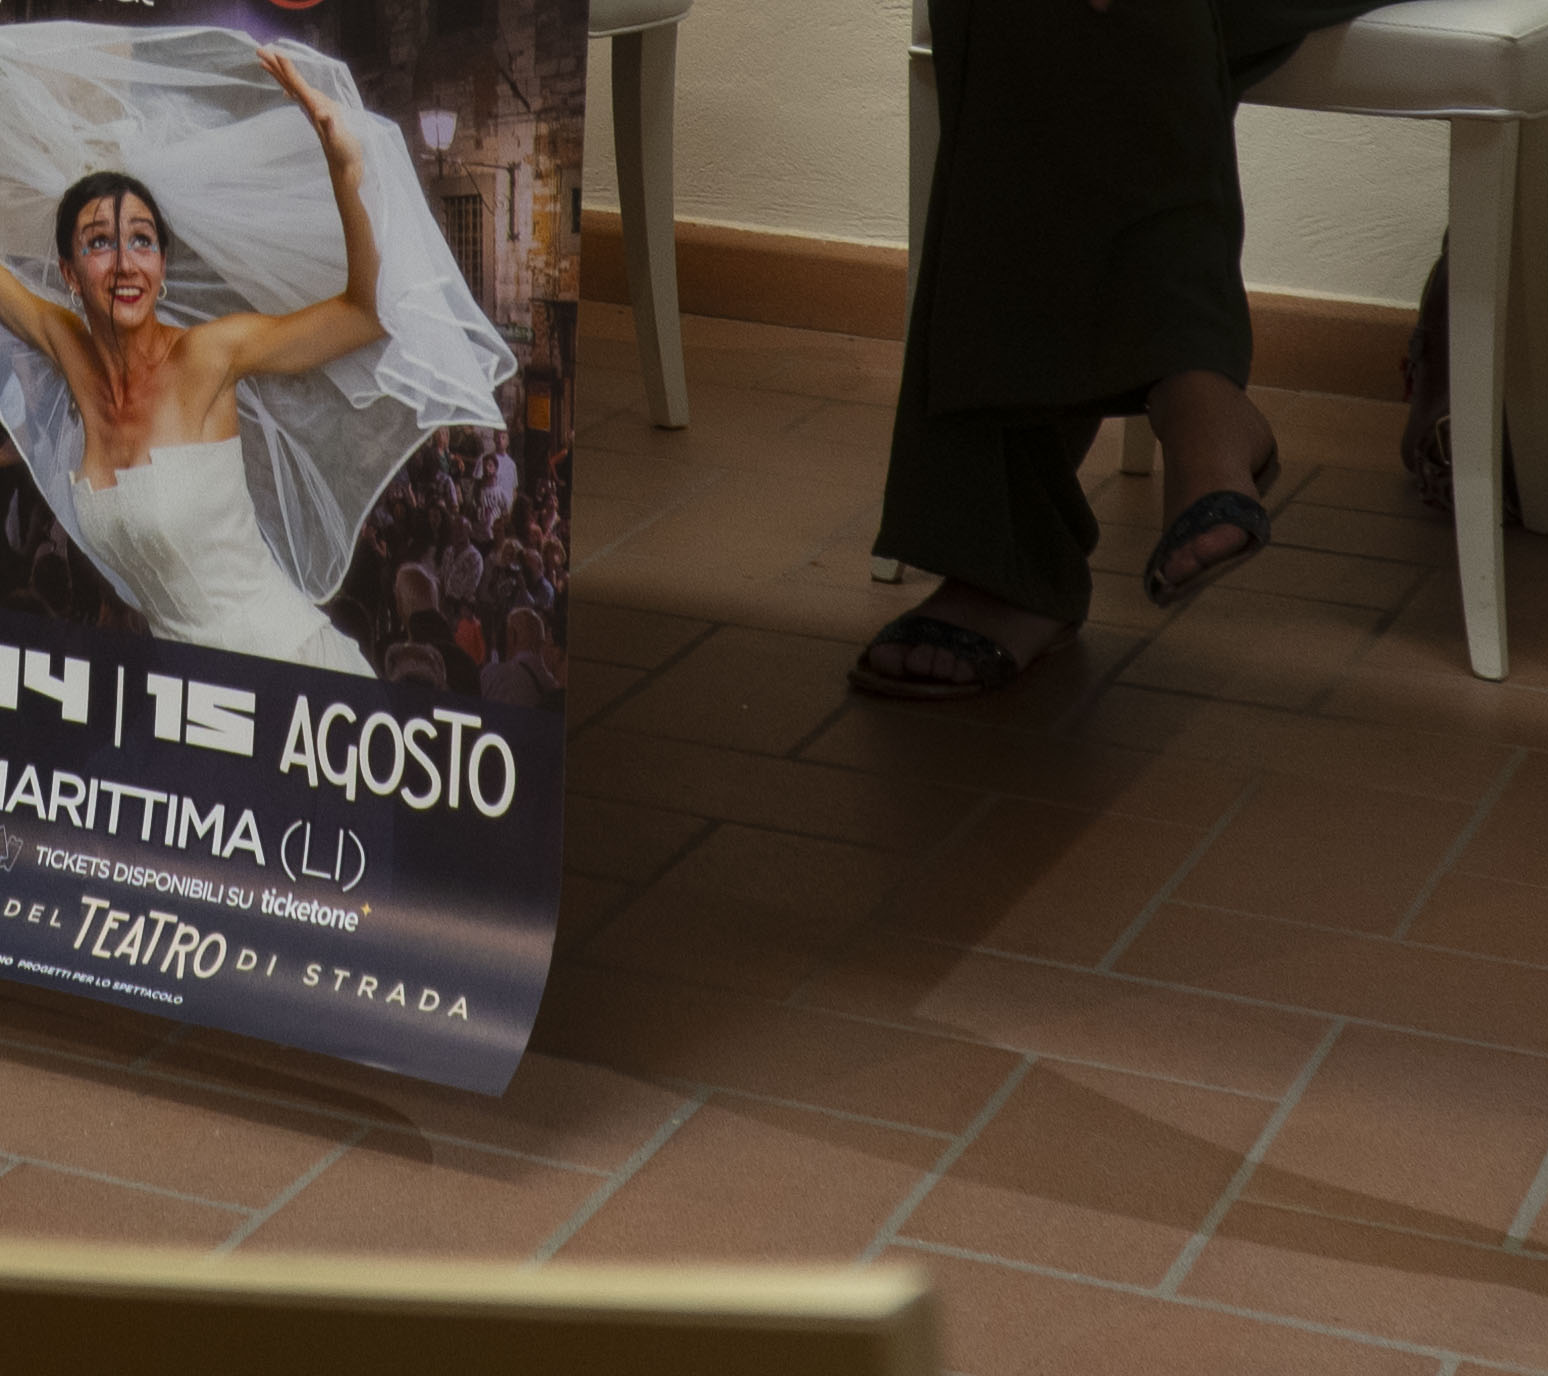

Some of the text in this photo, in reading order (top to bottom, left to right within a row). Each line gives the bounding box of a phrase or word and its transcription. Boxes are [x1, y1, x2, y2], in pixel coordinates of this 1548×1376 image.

[147, 672, 256, 757] 15
[279, 694, 516, 817] AGOSTO
[36, 845, 358, 932] TICKETS DISPONIBILI SU ticketone
[281, 820, 365, 893] (LI)
[3, 898, 61, 928] DEL
[73, 895, 227, 980] TEATRO
[236, 949, 277, 977] DI
[302, 962, 469, 1020] STRADA
[17, 958, 71, 981] PROGETTI
[72, 972, 95, 985] PER
[95, 977, 111, 989] LO
[112, 980, 184, 1005] SPETTACOLO
